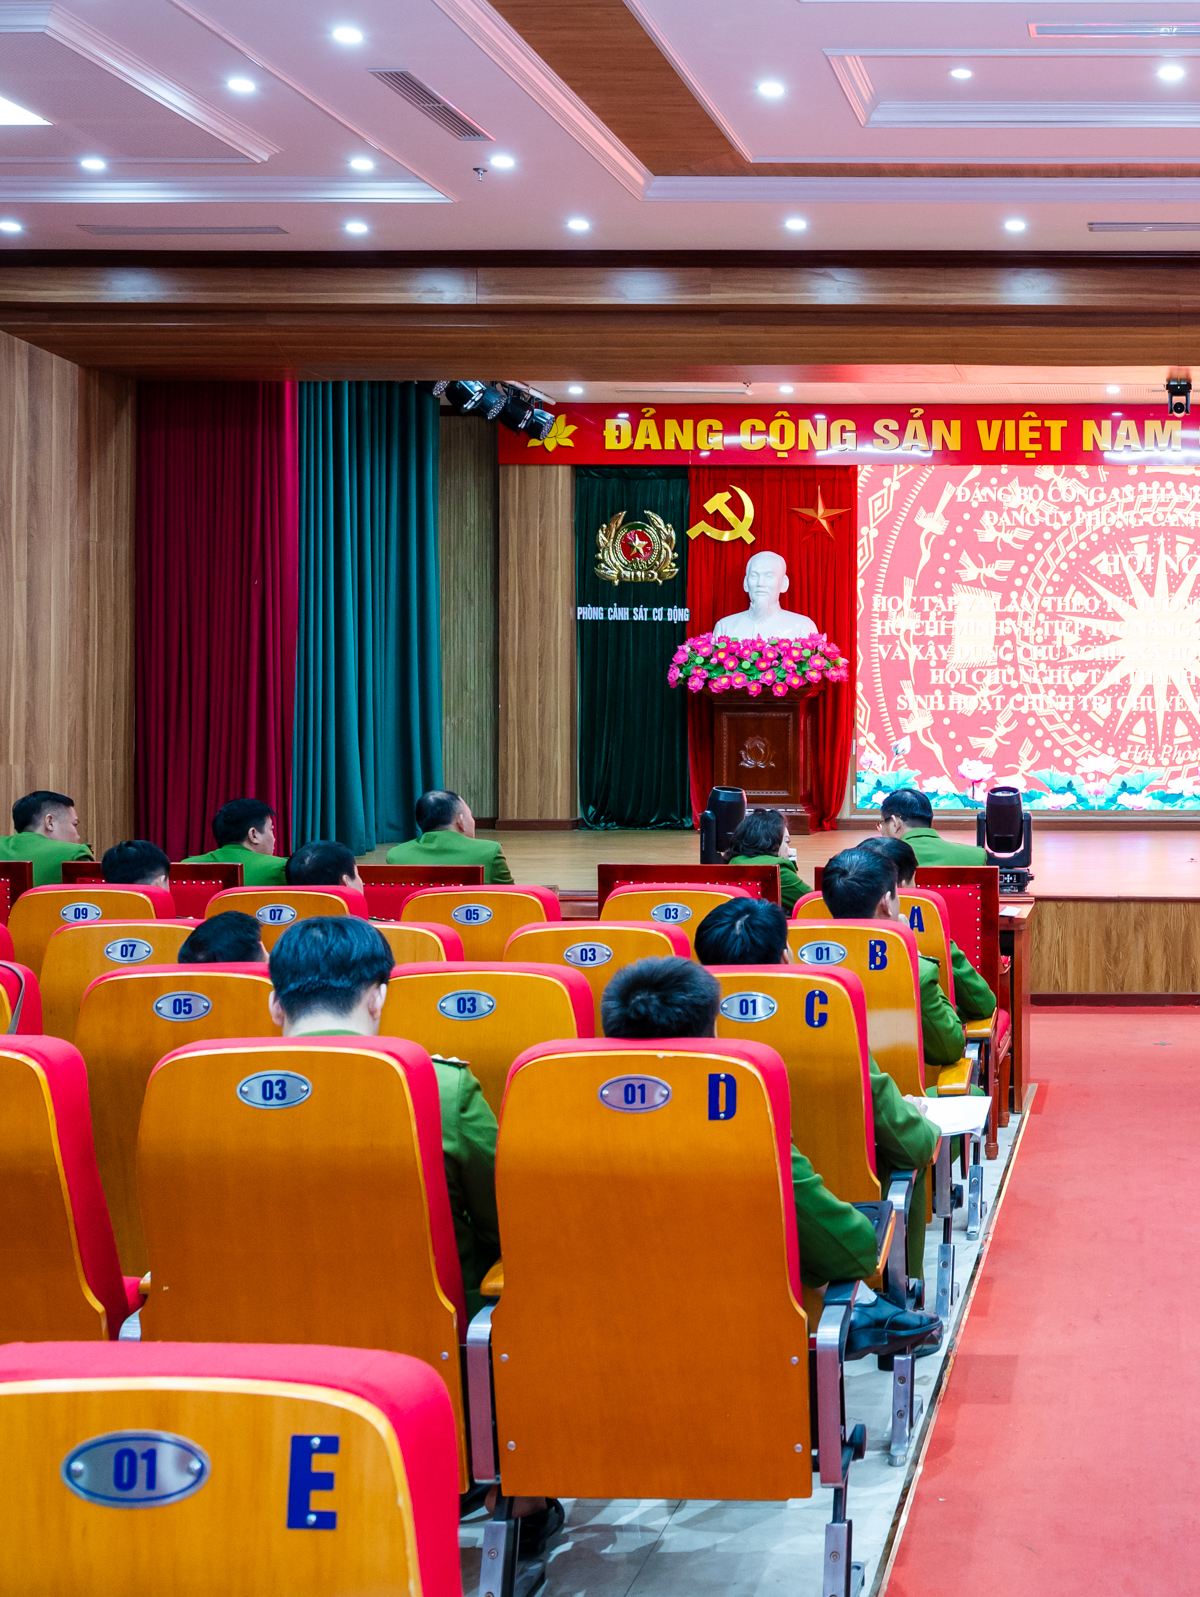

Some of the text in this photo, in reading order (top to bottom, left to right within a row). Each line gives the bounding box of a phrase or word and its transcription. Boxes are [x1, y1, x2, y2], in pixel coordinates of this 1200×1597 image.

[603, 408, 726, 451] ĐẢNG
[740, 411, 857, 457] CỘNG
[873, 408, 961, 451] SẢN
[976, 411, 1067, 458] VIỆT
[1082, 420, 1182, 452] NAM
[956, 482, 1011, 502] ĐẢNG
[1108, 487, 1135, 502] AN
[985, 507, 1041, 526] ĐẢNG
[577, 603, 690, 624] PHÒNG CẢNH SÁT CƠ ĐỘNG
[911, 615, 946, 636] CHÍ
[878, 640, 906, 660] VÀ
[911, 640, 951, 661] XÂY
[897, 695, 943, 711] SINH
[73, 907, 88, 920] 09
[269, 908, 284, 921] 07
[465, 908, 480, 921] 05
[664, 907, 679, 920] 03
[909, 907, 924, 932] A
[120, 943, 137, 958] 07
[579, 947, 597, 962] 03
[815, 946, 830, 961] 01
[869, 940, 887, 970] B
[172, 997, 193, 1016] 05
[456, 996, 477, 1014] 03
[739, 998, 757, 1016] 01
[806, 990, 827, 1027] C
[261, 1078, 287, 1101] 03
[623, 1083, 646, 1106] 01
[709, 1074, 736, 1120] D
[114, 1448, 157, 1492] 01
[287, 1436, 339, 1529] E
